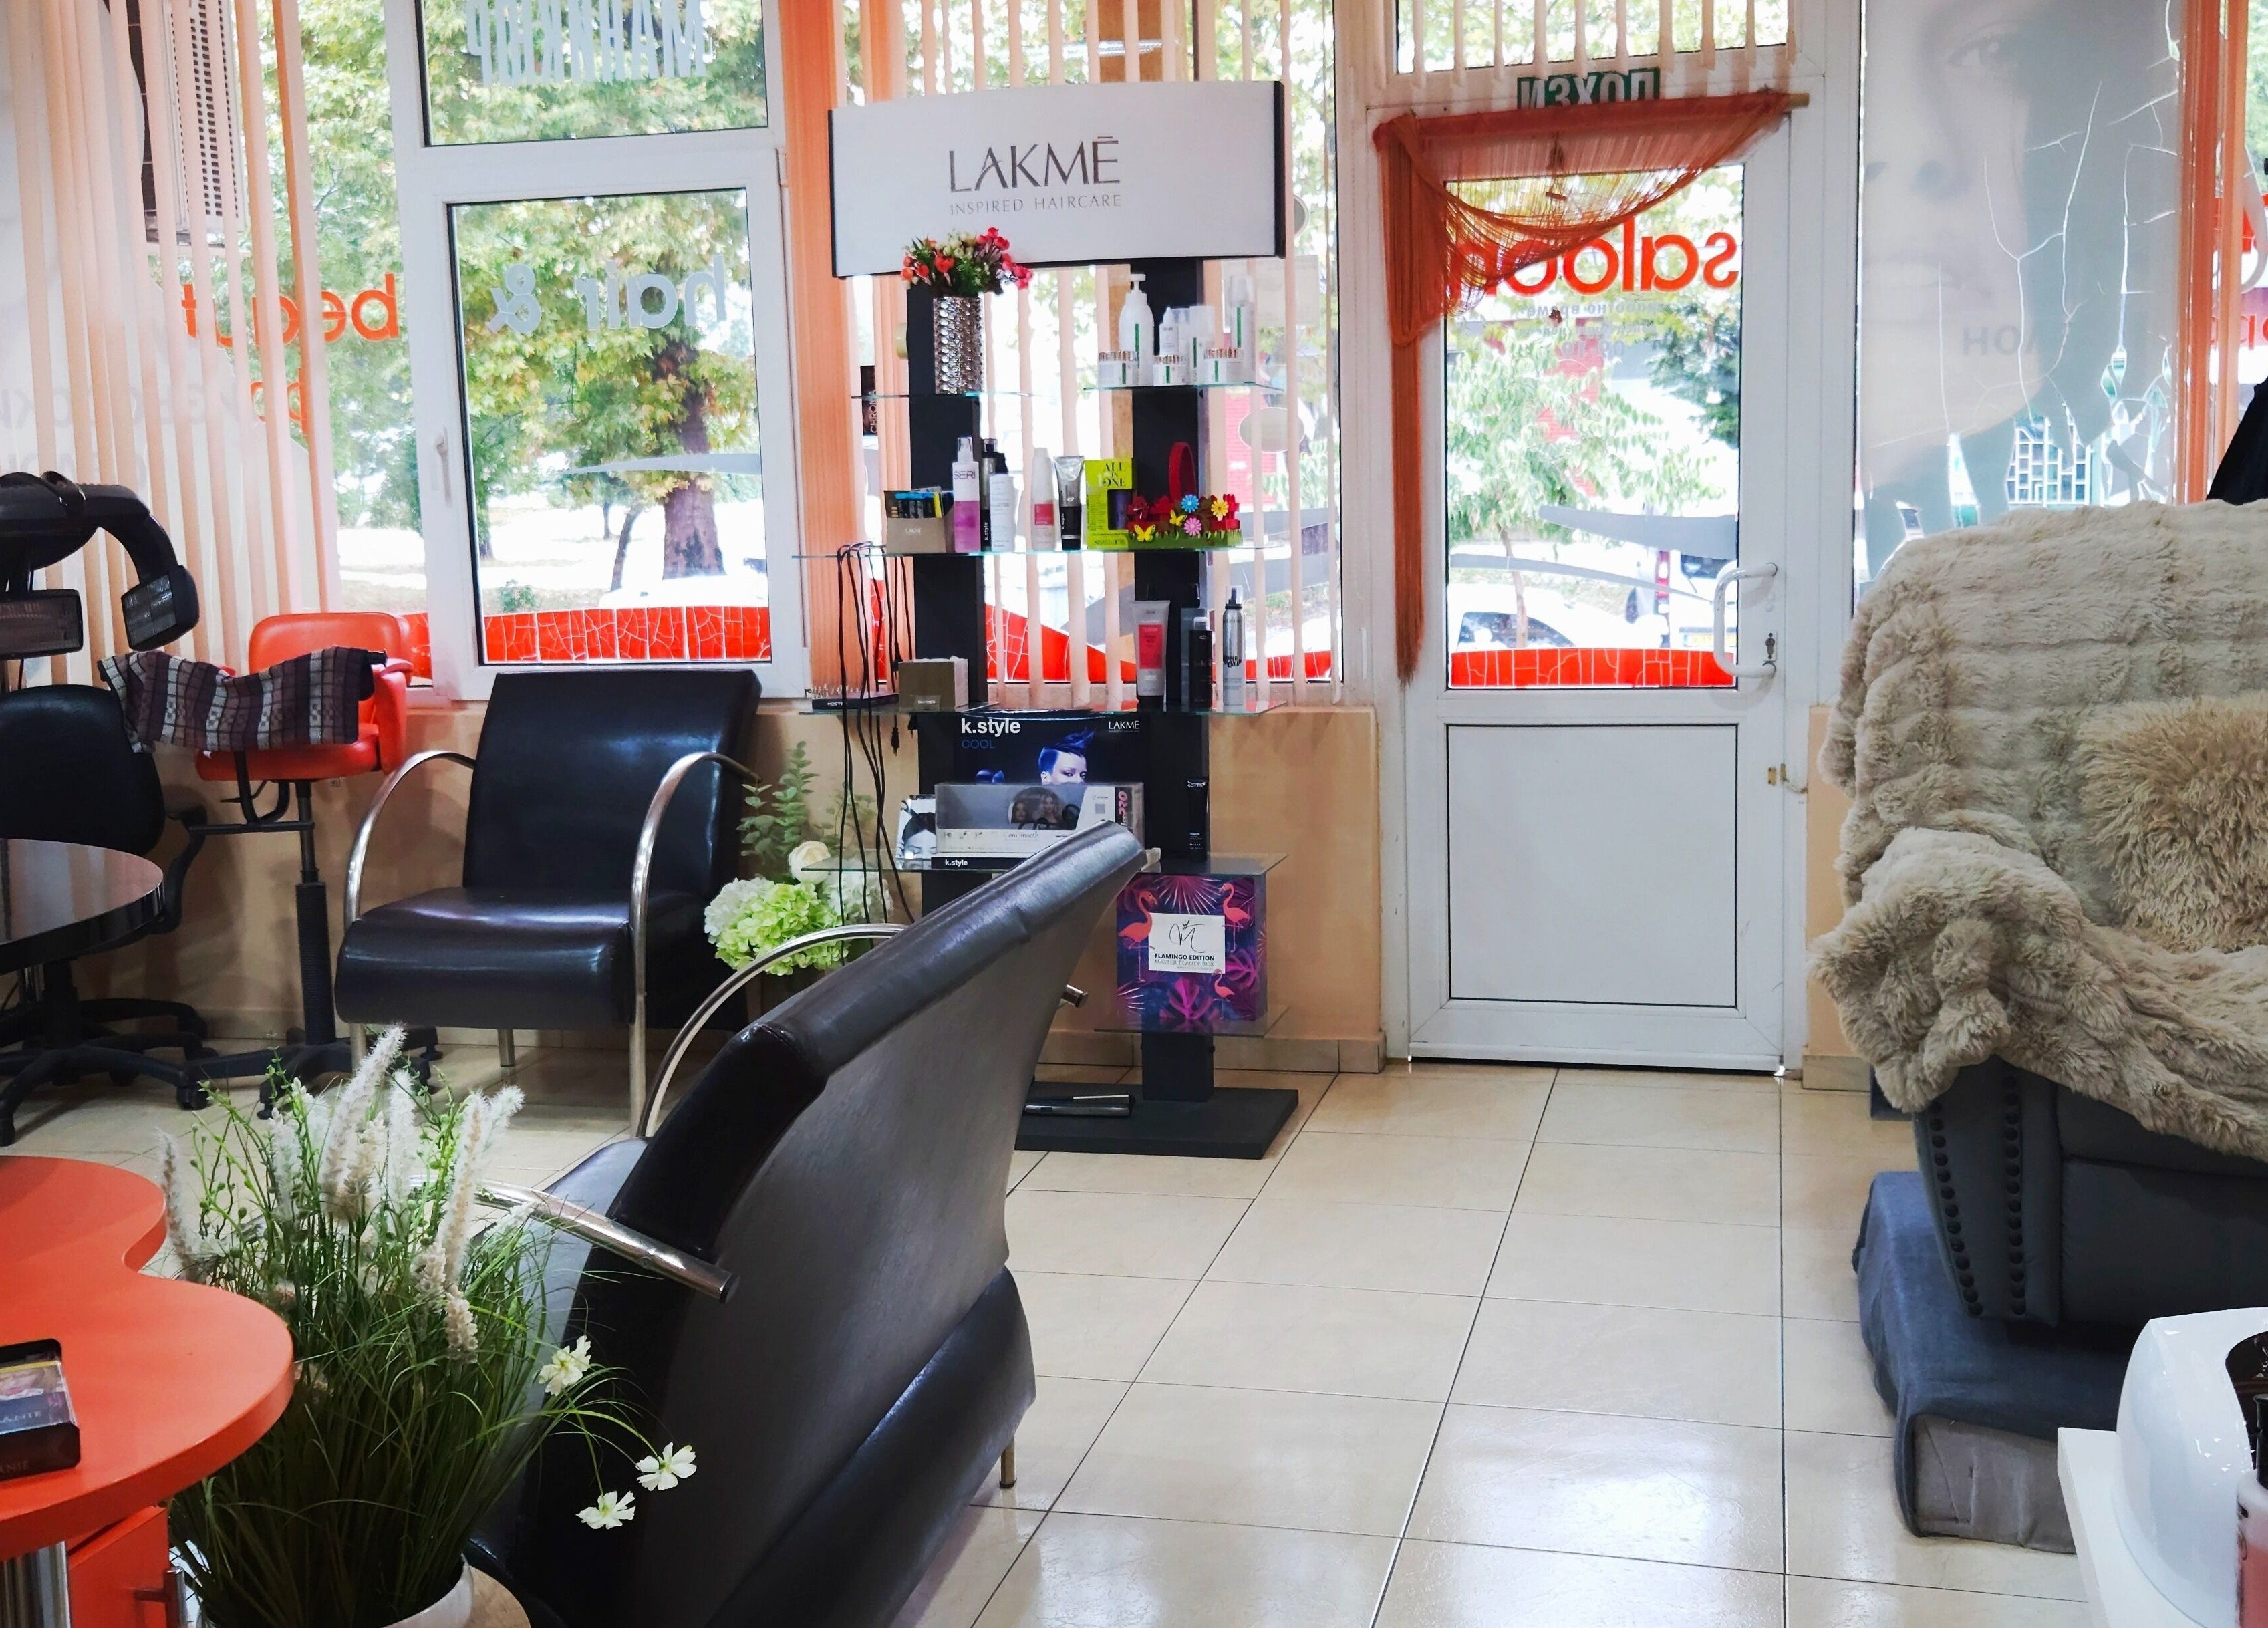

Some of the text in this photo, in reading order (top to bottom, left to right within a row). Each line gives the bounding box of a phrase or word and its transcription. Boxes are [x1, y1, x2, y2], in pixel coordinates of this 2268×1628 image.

[950, 194, 1122, 216] INSPIRED HAIRCARE
[961, 718, 1021, 738] k.style
[962, 740, 994, 749] COOL
[944, 859, 968, 867] k.style
